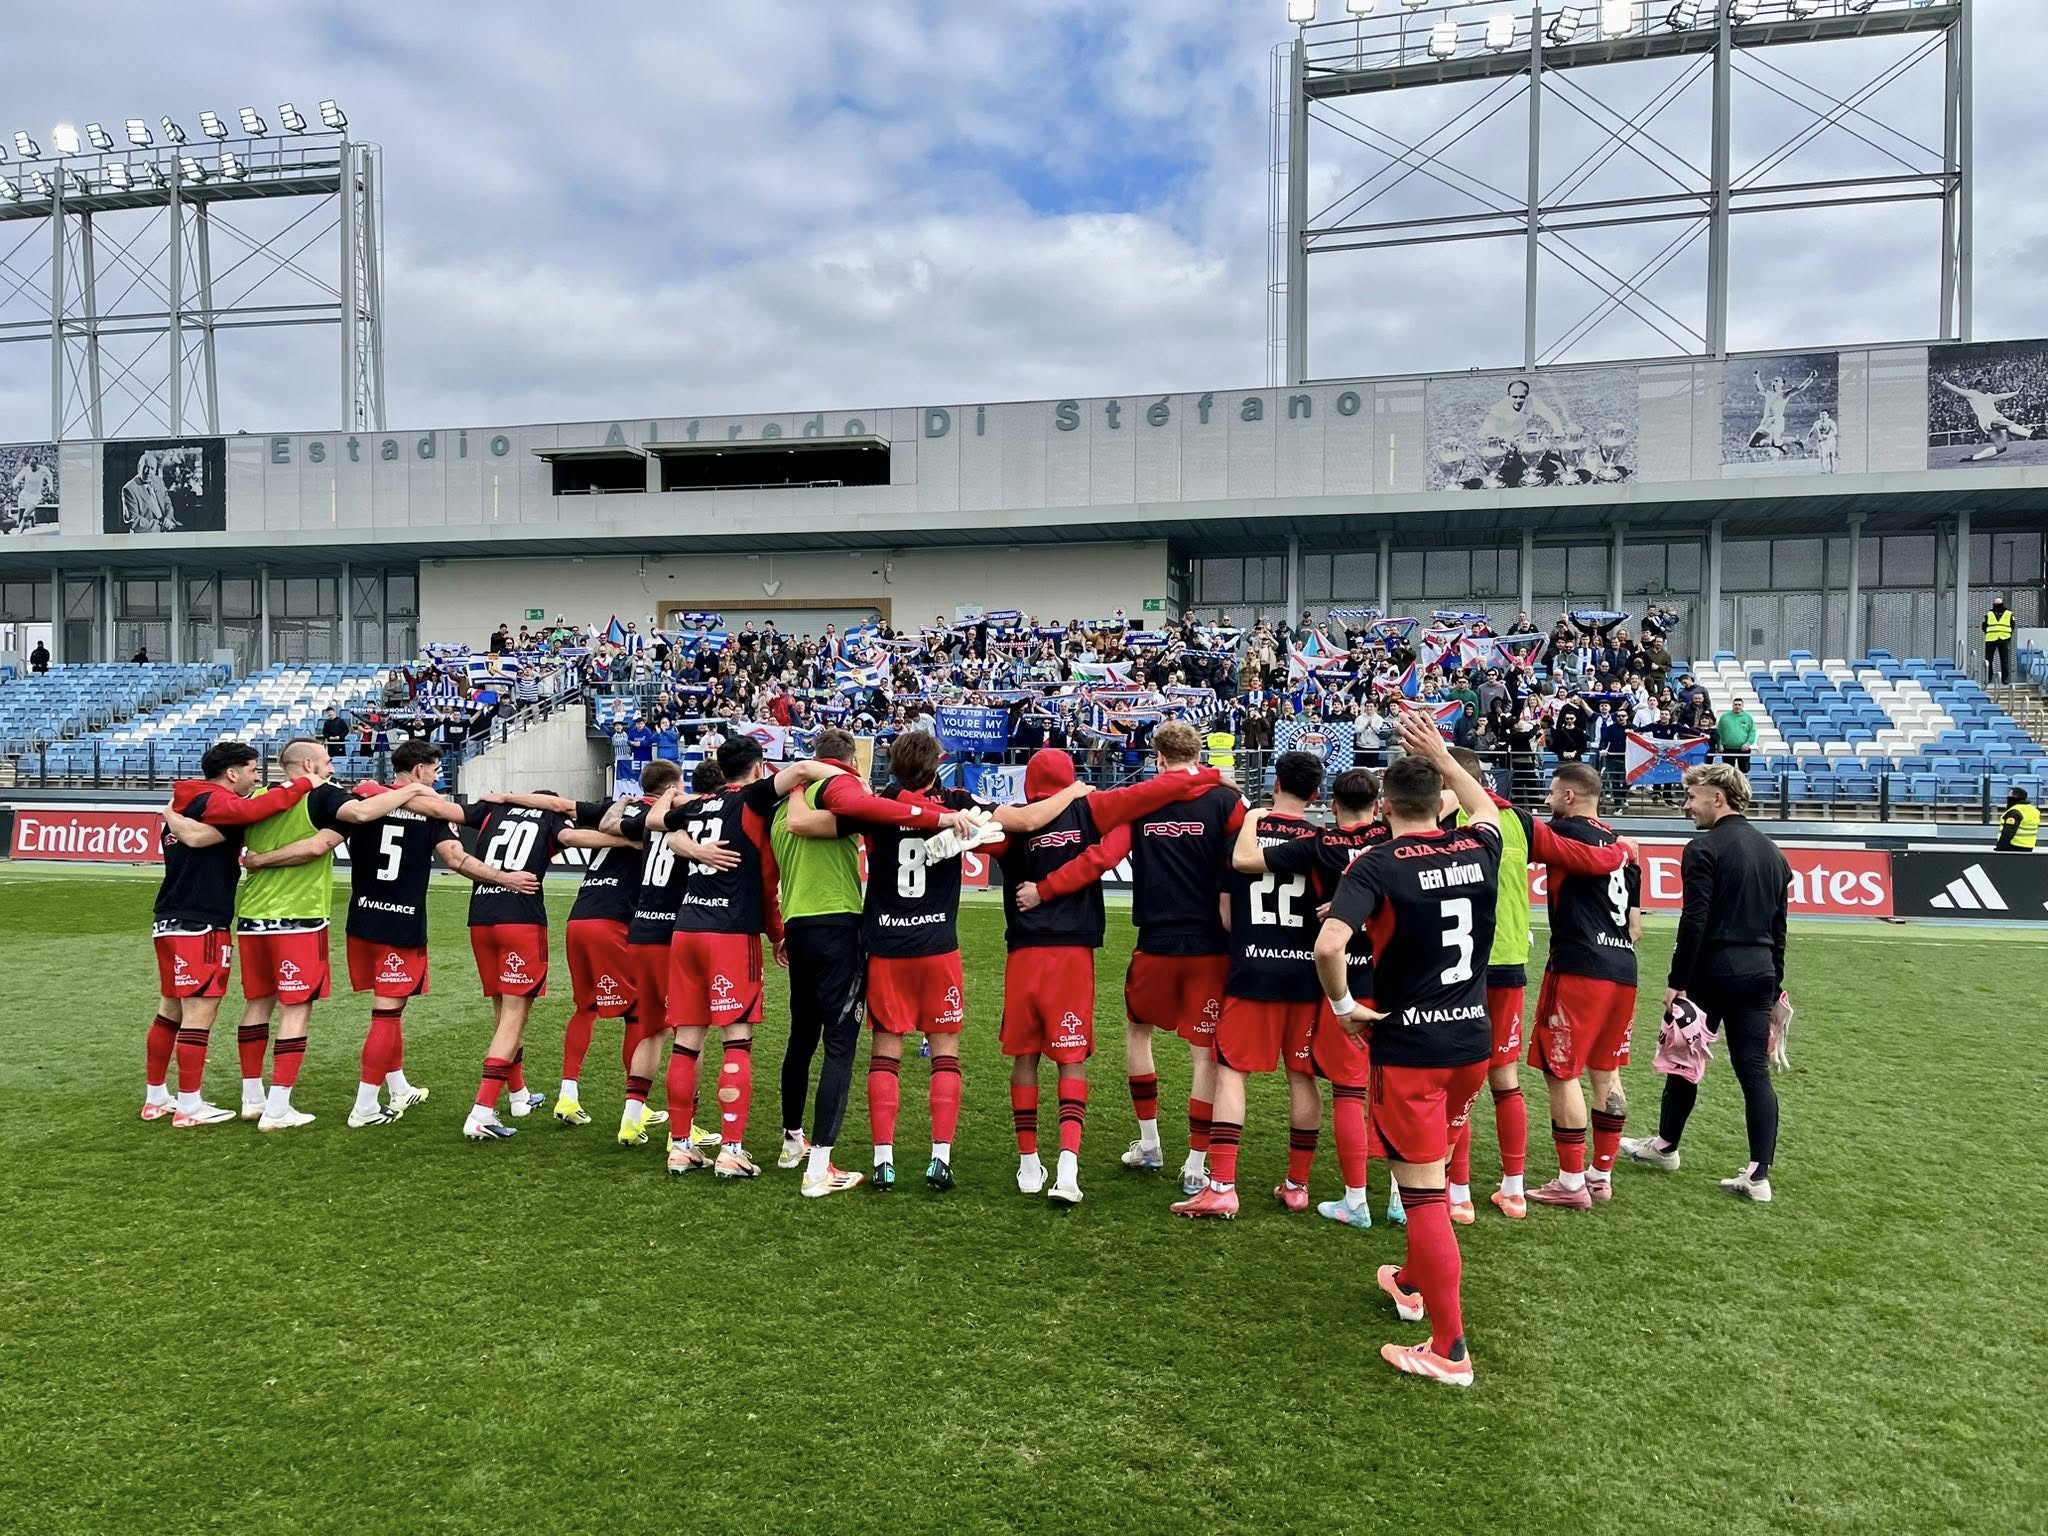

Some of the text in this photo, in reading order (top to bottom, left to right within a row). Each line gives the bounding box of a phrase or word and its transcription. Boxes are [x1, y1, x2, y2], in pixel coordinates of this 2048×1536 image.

[271, 390, 1361, 464] Estadio Alfredo Di Stéfano
[943, 718, 1002, 729] YOU'RE MY
[960, 709, 982, 717] AFTER
[942, 728, 1002, 738] WONDERWALL
[18, 819, 149, 854] Emirates
[485, 820, 539, 871] 20
[1322, 836, 1352, 847] CAJA
[1394, 844, 1436, 859] CAJA
[377, 824, 405, 881] 5
[642, 831, 676, 888] 18
[898, 837, 926, 898] 8
[1418, 861, 1485, 891] GER NÓVOA
[1646, 856, 1885, 906] Eates
[367, 900, 416, 915] VALCARCE
[1250, 872, 1306, 928] 22
[1608, 865, 1629, 927] 9
[891, 912, 946, 927] VALCARCE
[1258, 948, 1315, 962] VALCARCE
[1440, 897, 1474, 985] 3
[1052, 1039, 1088, 1048] PONFERRAD
[1060, 1034, 1085, 1042] CLINICA
